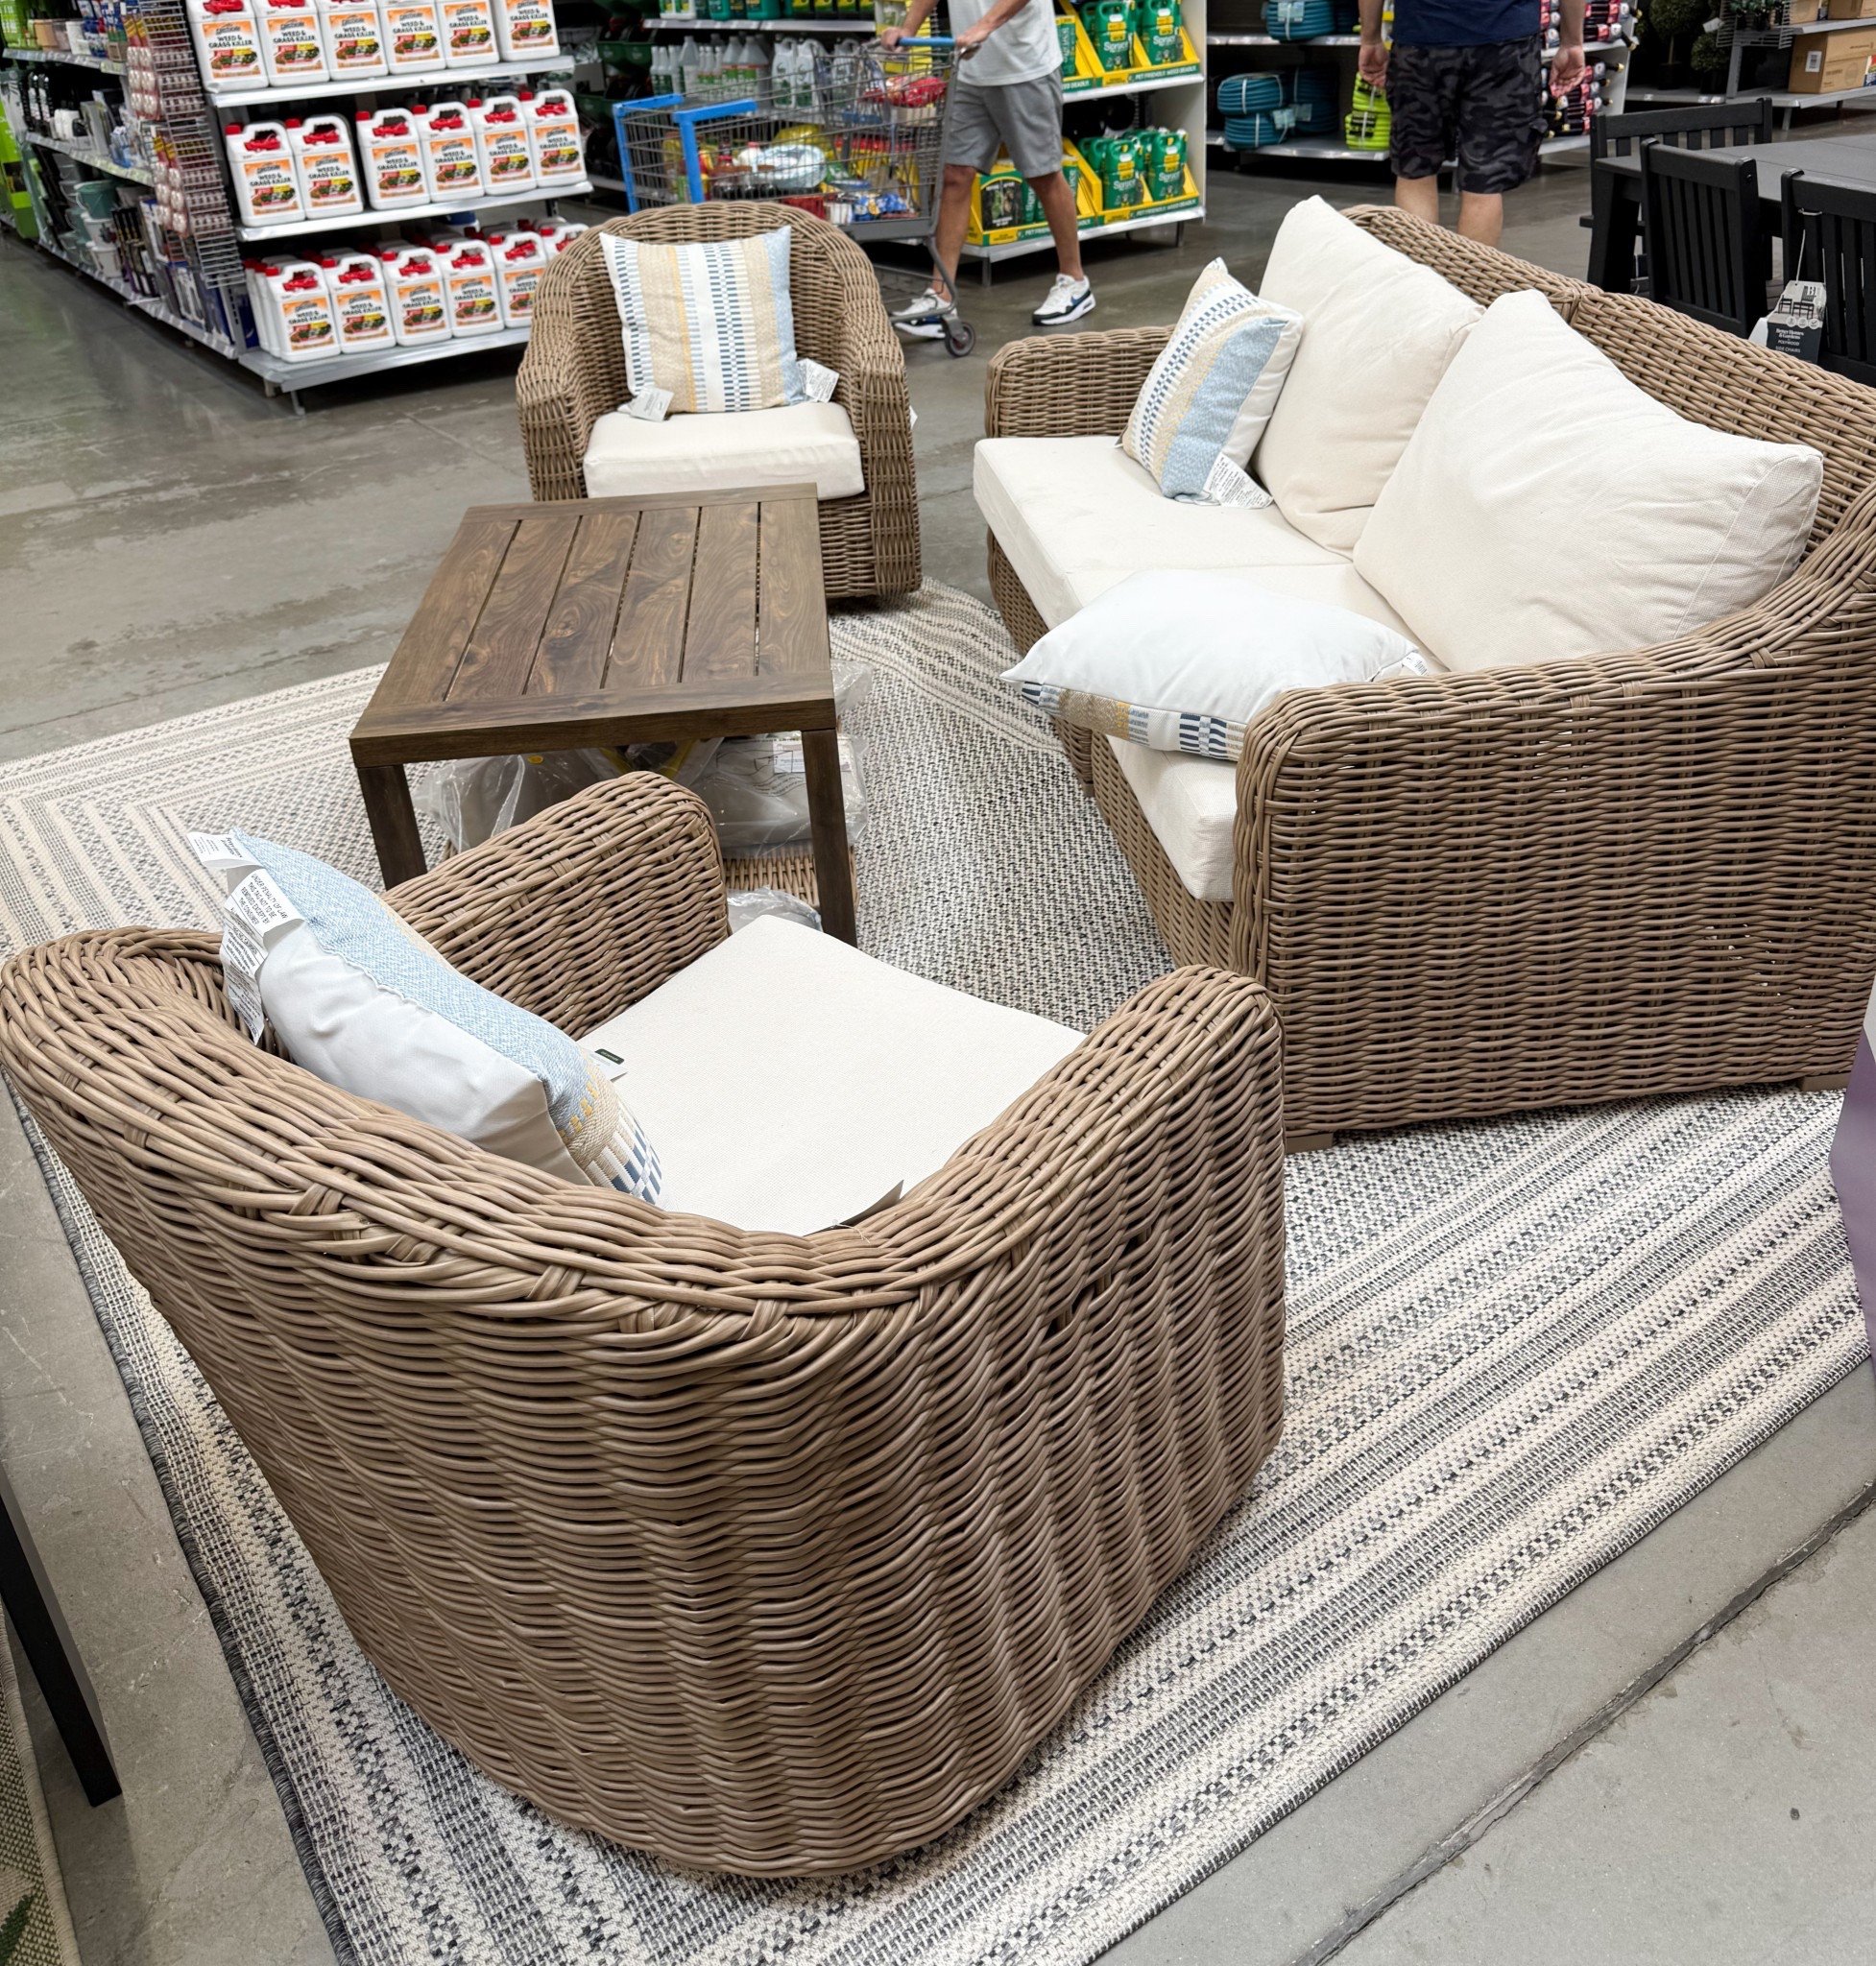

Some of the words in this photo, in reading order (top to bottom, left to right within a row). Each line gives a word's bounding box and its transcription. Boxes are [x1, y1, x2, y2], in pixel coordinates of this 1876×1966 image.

[251, 873, 264, 887] UNDER
[241, 887, 255, 904] REMOVED
[252, 904, 267, 918] EXCEPT
[248, 882, 257, 892] THIS
[253, 891, 262, 899] TAG
[259, 898, 268, 906] NOT
[244, 906, 260, 925] CONSUMER
